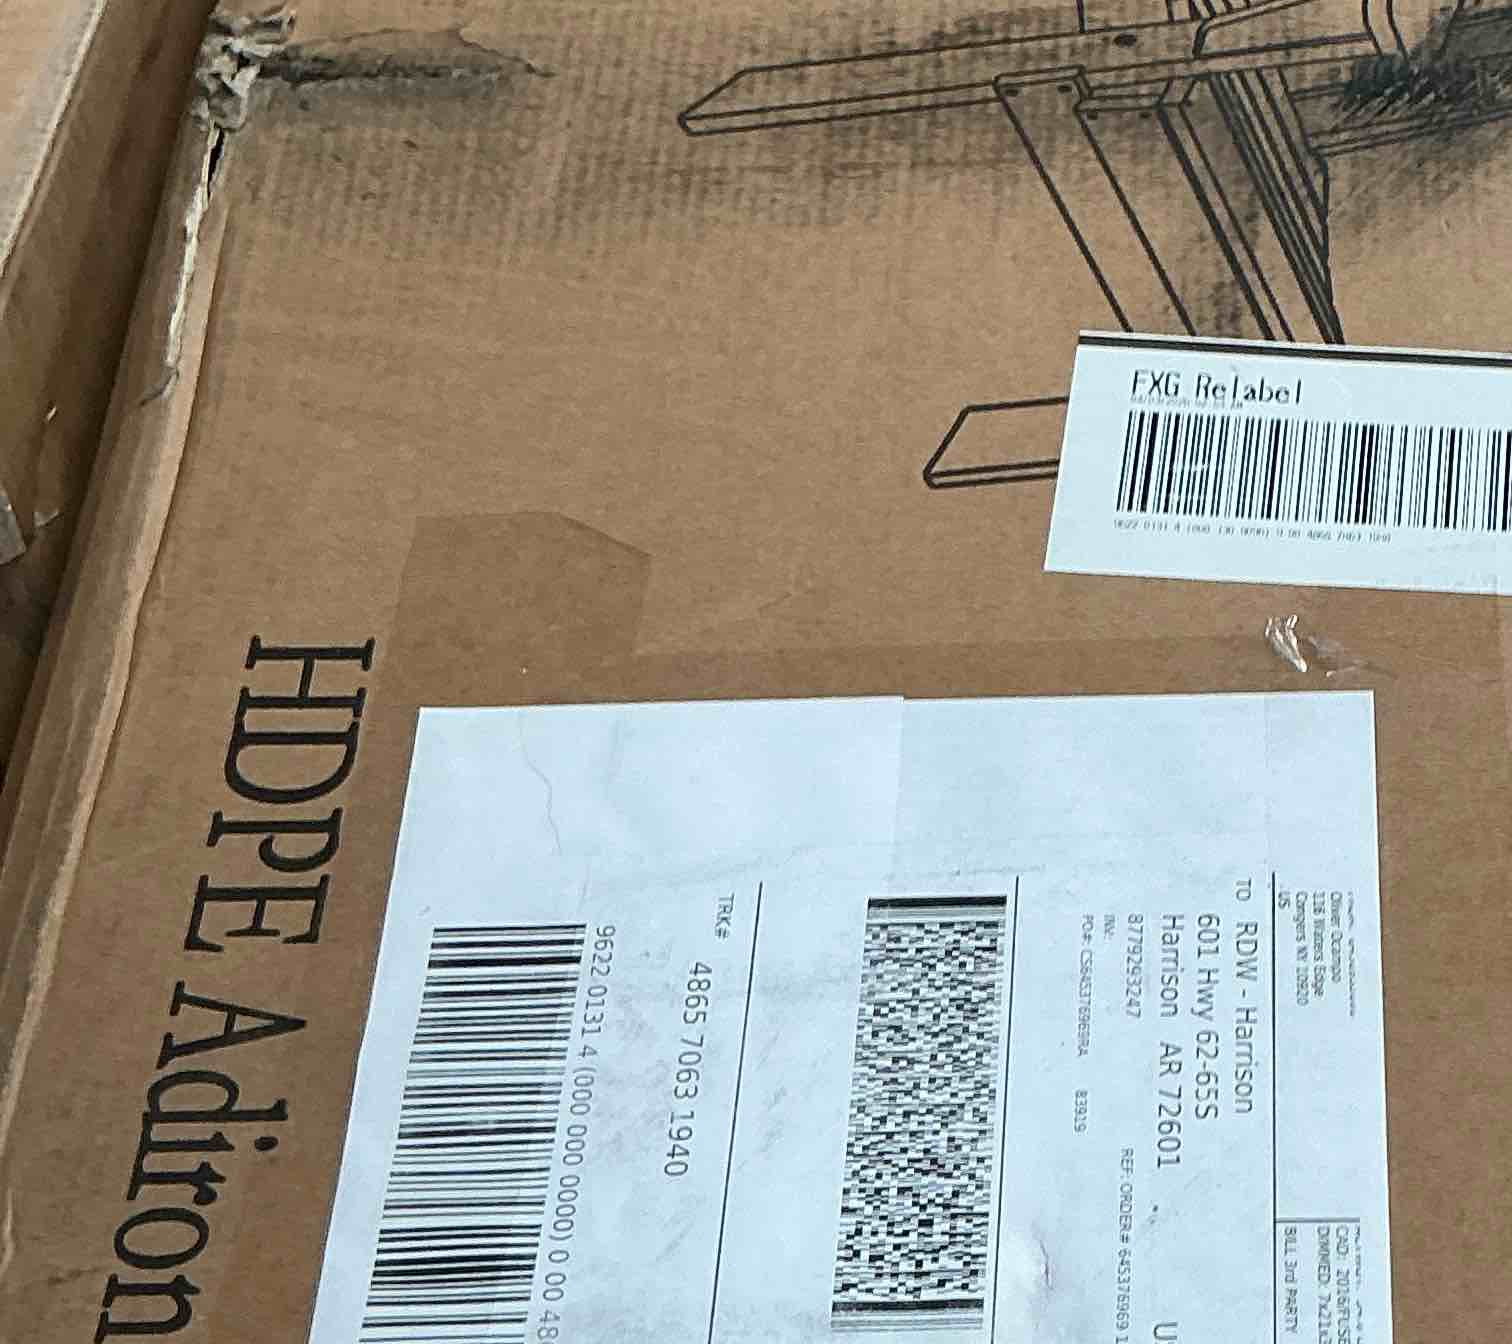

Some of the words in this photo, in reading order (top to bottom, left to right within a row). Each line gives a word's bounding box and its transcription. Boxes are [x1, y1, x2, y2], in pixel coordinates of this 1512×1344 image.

[1132, 370, 1180, 397] FXG
[1196, 374, 1301, 405] Relabel
[184, 637, 374, 951] HDPE
[1236, 879, 1251, 901] TO
[1278, 892, 1290, 909] US
[713, 894, 735, 941] TRK#
[1080, 914, 1093, 946] PO#:
[1197, 914, 1219, 957] 601
[591, 925, 615, 977] 9622
[1126, 914, 1142, 1018] 8779293247
[1160, 914, 1183, 1017] Harrison
[1235, 922, 1257, 981] RDW
[684, 961, 713, 1025] 4865
[1192, 968, 1218, 1020] Hwy
[1311, 966, 1326, 997] Edge
[580, 985, 607, 1036] 0131
[577, 1045, 599, 1058] 4
[673, 1035, 704, 1099] 7063
[1158, 1042, 1181, 1077] AR
[1195, 1030, 1218, 1120] 62-65S
[1235, 1007, 1258, 1114] Harrison
[569, 1066, 598, 1114] (000
[563, 1124, 589, 1169] 000
[663, 1110, 694, 1177] 1940
[1157, 1086, 1181, 1168] 72601
[1120, 1148, 1133, 1179] REF:
[549, 1174, 582, 1242] 0000)
[1119, 1183, 1133, 1244] ORDER#
[548, 1250, 570, 1264] 0
[1285, 1227, 1297, 1256] BILL
[542, 1273, 567, 1301] 00
[1285, 1260, 1297, 1283] 3rd
[1285, 1288, 1297, 1334] PARTY
[1116, 1335, 1129, 1344] 1
